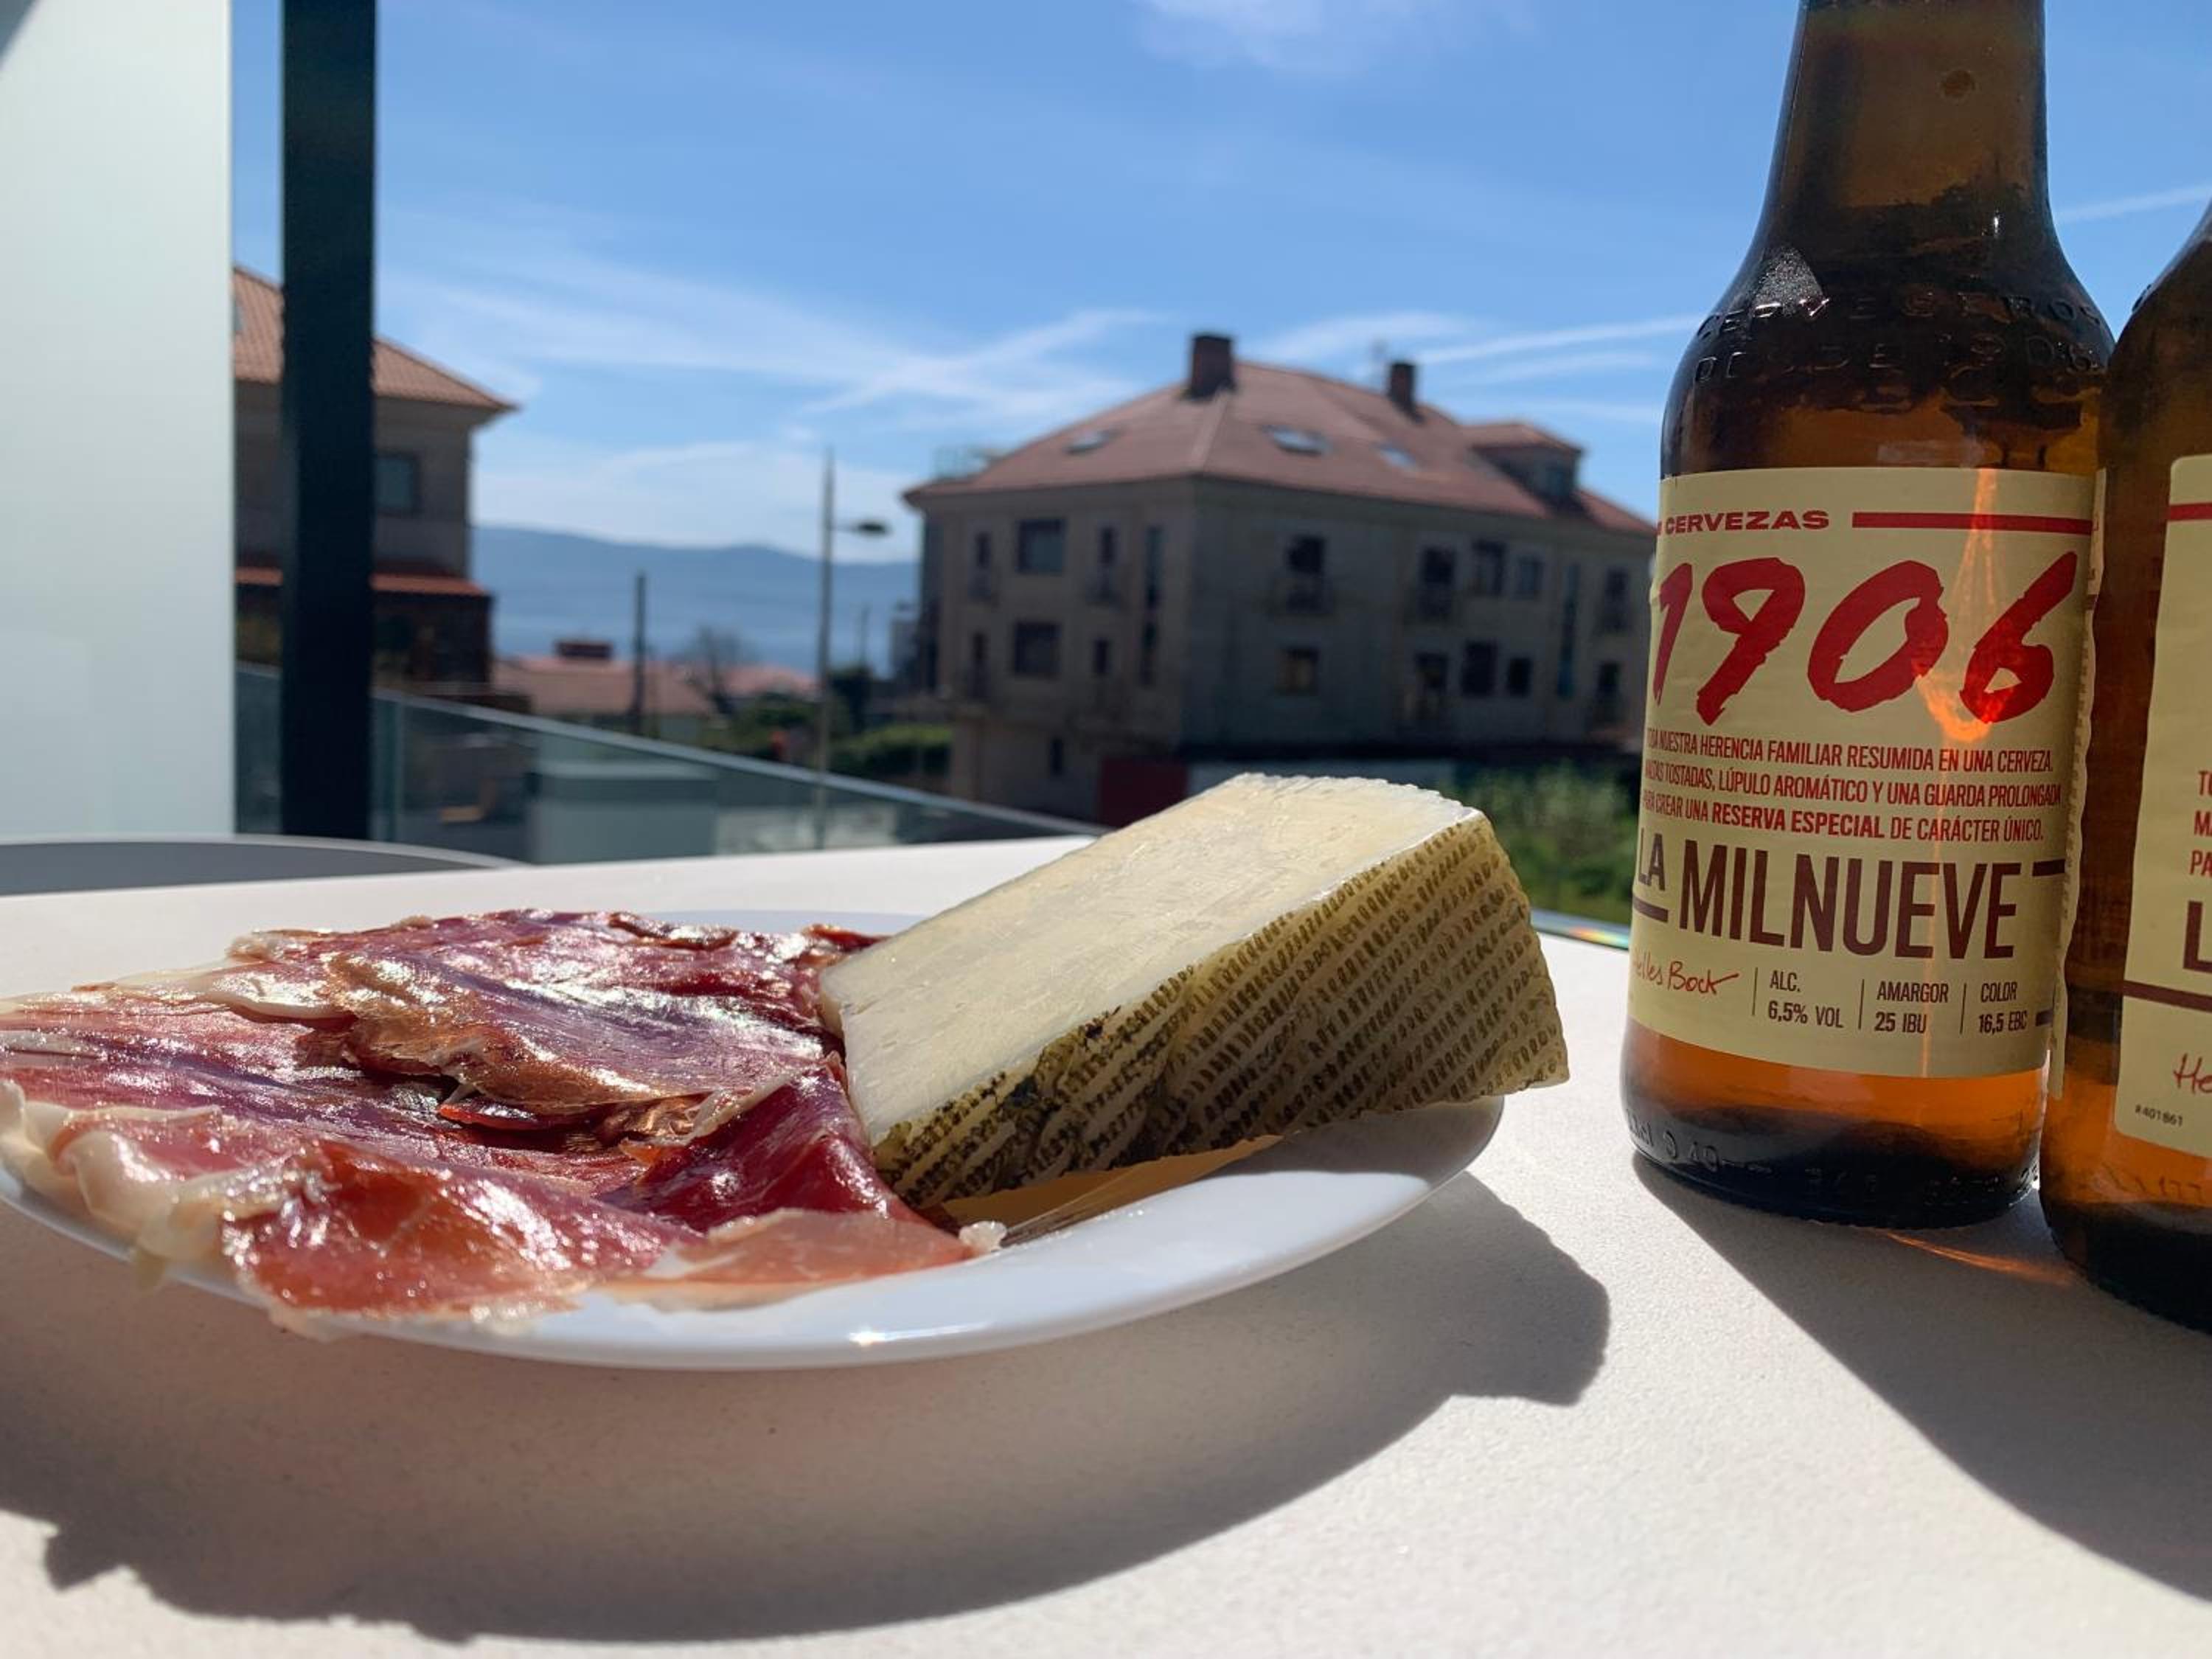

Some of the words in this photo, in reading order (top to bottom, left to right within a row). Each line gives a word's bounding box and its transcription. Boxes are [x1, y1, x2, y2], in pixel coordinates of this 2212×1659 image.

[1666, 509, 1829, 535] CERVEZAS
[1652, 551, 2079, 726] 1906
[1659, 730, 1697, 755] NUESTRA
[1700, 735, 1763, 762] HERENCIA
[1767, 740, 1843, 768] FAMILIAR
[1847, 745, 1933, 771] RESUMIDA
[1938, 748, 1959, 772] EN
[1963, 749, 1993, 772] UNA
[1997, 750, 2053, 773] CERVEZA.
[1665, 762, 1716, 791] TOSTADAS,
[1719, 767, 1770, 796] LÚPULO
[1773, 774, 1868, 804] AROMÁTICO
[1873, 780, 1885, 804] Y
[1887, 782, 1921, 805] UNA
[1924, 783, 1985, 807] GUARDA
[1989, 785, 2062, 807] PROLONGADA
[1685, 799, 1708, 822] UNA
[1712, 802, 1785, 831] RESERVA
[1791, 810, 1885, 839] ESPECIAL
[1891, 816, 1913, 839] DE
[1917, 815, 1999, 841] CARÁCTER
[2003, 816, 2044, 841] ÚNICO.
[1638, 827, 1666, 891] LA
[1680, 840, 2020, 959] MILNUEVE
[1667, 960, 1740, 995] Bock
[1770, 970, 1801, 992] ALC.
[1877, 980, 1949, 1004] AMARGOR
[1980, 981, 2018, 1004] COLOR
[1768, 1000, 1809, 1024] 6,5%
[1815, 1004, 1845, 1029] VOL
[1874, 1011, 1896, 1032] 25
[1902, 1012, 1927, 1034] IBU
[1978, 1012, 2004, 1035] 16,5
[2008, 1010, 2028, 1032] EBC
